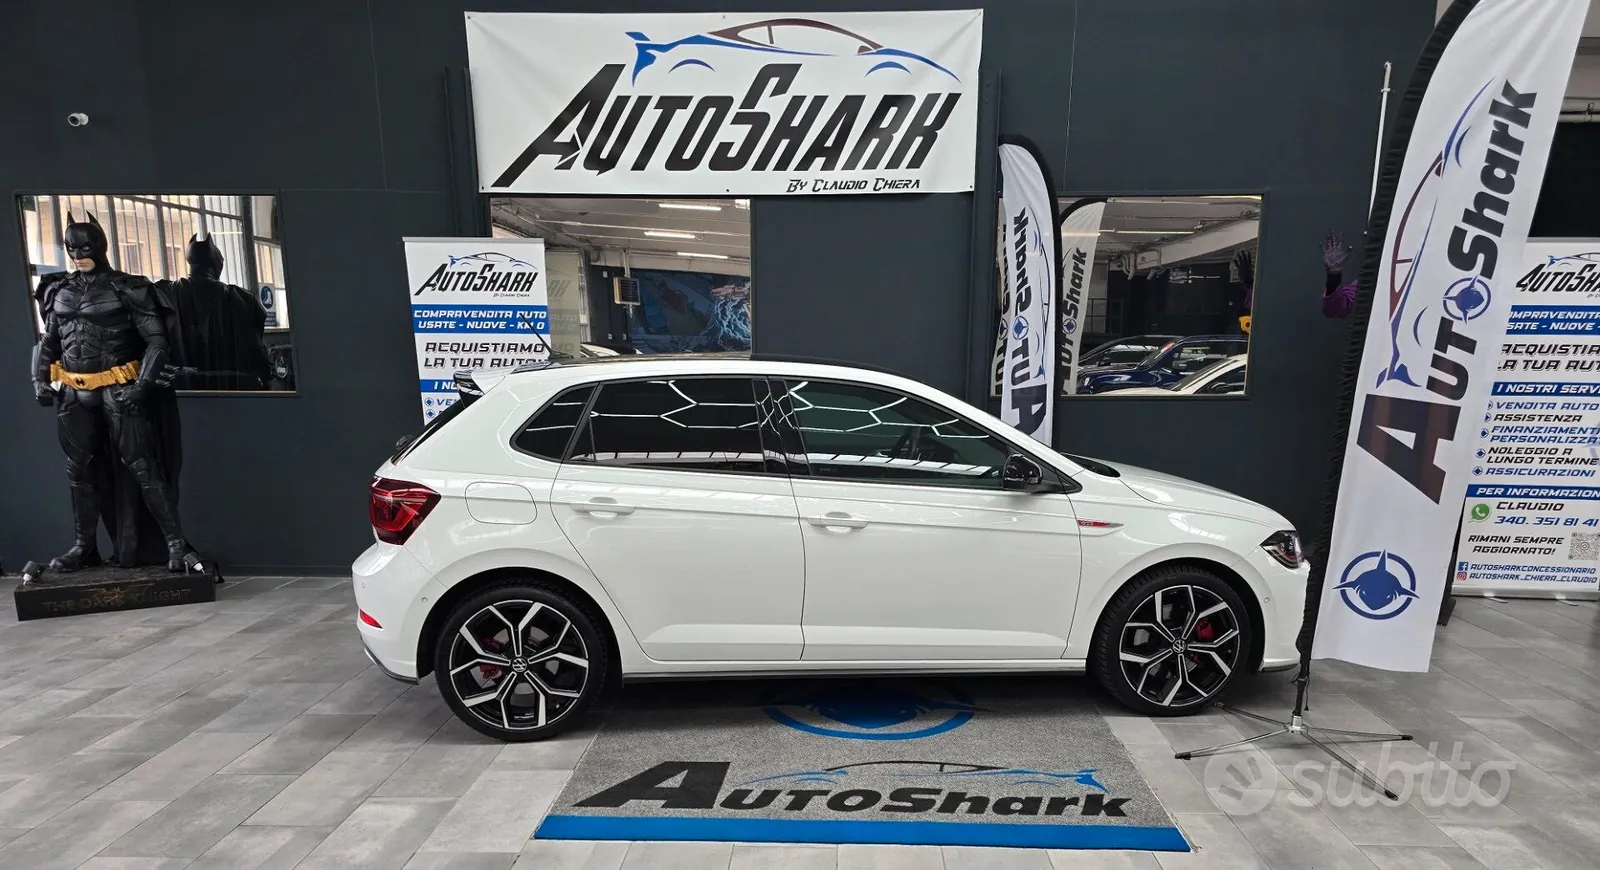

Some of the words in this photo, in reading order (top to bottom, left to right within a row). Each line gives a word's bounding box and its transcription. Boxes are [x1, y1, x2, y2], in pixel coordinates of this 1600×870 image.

[490, 63, 962, 188] AUTOSHARK
[786, 179, 807, 193] BY
[811, 178, 868, 192] CLAUDIO
[873, 177, 920, 191] CHIERA
[414, 263, 539, 296] AUTOSHARK
[414, 310, 513, 319] COMPRAVENDITA
[516, 311, 547, 319] AUTO
[418, 321, 457, 330] USATE
[466, 321, 507, 330] NUOVE
[1549, 322, 1595, 331] NUOVE
[425, 342, 546, 354] ACQUISTIAMO
[424, 358, 446, 368] LA
[450, 358, 484, 368] TUA
[1523, 360, 1561, 371] TUA
[434, 381, 439, 390] I
[1497, 384, 1504, 393] I
[1505, 384, 1558, 393] NOSTRI
[1496, 401, 1557, 410] VENDITA
[1561, 402, 1600, 411] AUTO
[1493, 413, 1583, 422] ASSISTENZA
[1490, 435, 1600, 445] PERSONALIZZA
[1488, 447, 1559, 455] NOLEGGIO
[1562, 448, 1573, 456] A
[1486, 456, 1535, 464] LUNGO
[1538, 457, 1600, 466] TERMINE
[1485, 467, 1596, 477] ASSICURAZIONI
[1476, 487, 1504, 495] PER
[1496, 501, 1565, 511] CLAUDIO
[1494, 515, 1529, 525] 340.
[1532, 516, 1559, 526] 351
[1563, 517, 1579, 527] 81
[1582, 518, 1600, 527] 41
[1468, 535, 1511, 543] RIMANI
[1513, 536, 1565, 545] SEMPRE
[1472, 545, 1556, 555] AGGIORNATO!
[1470, 563, 1597, 574] AUTOSHARKCONCESSIONARIO
